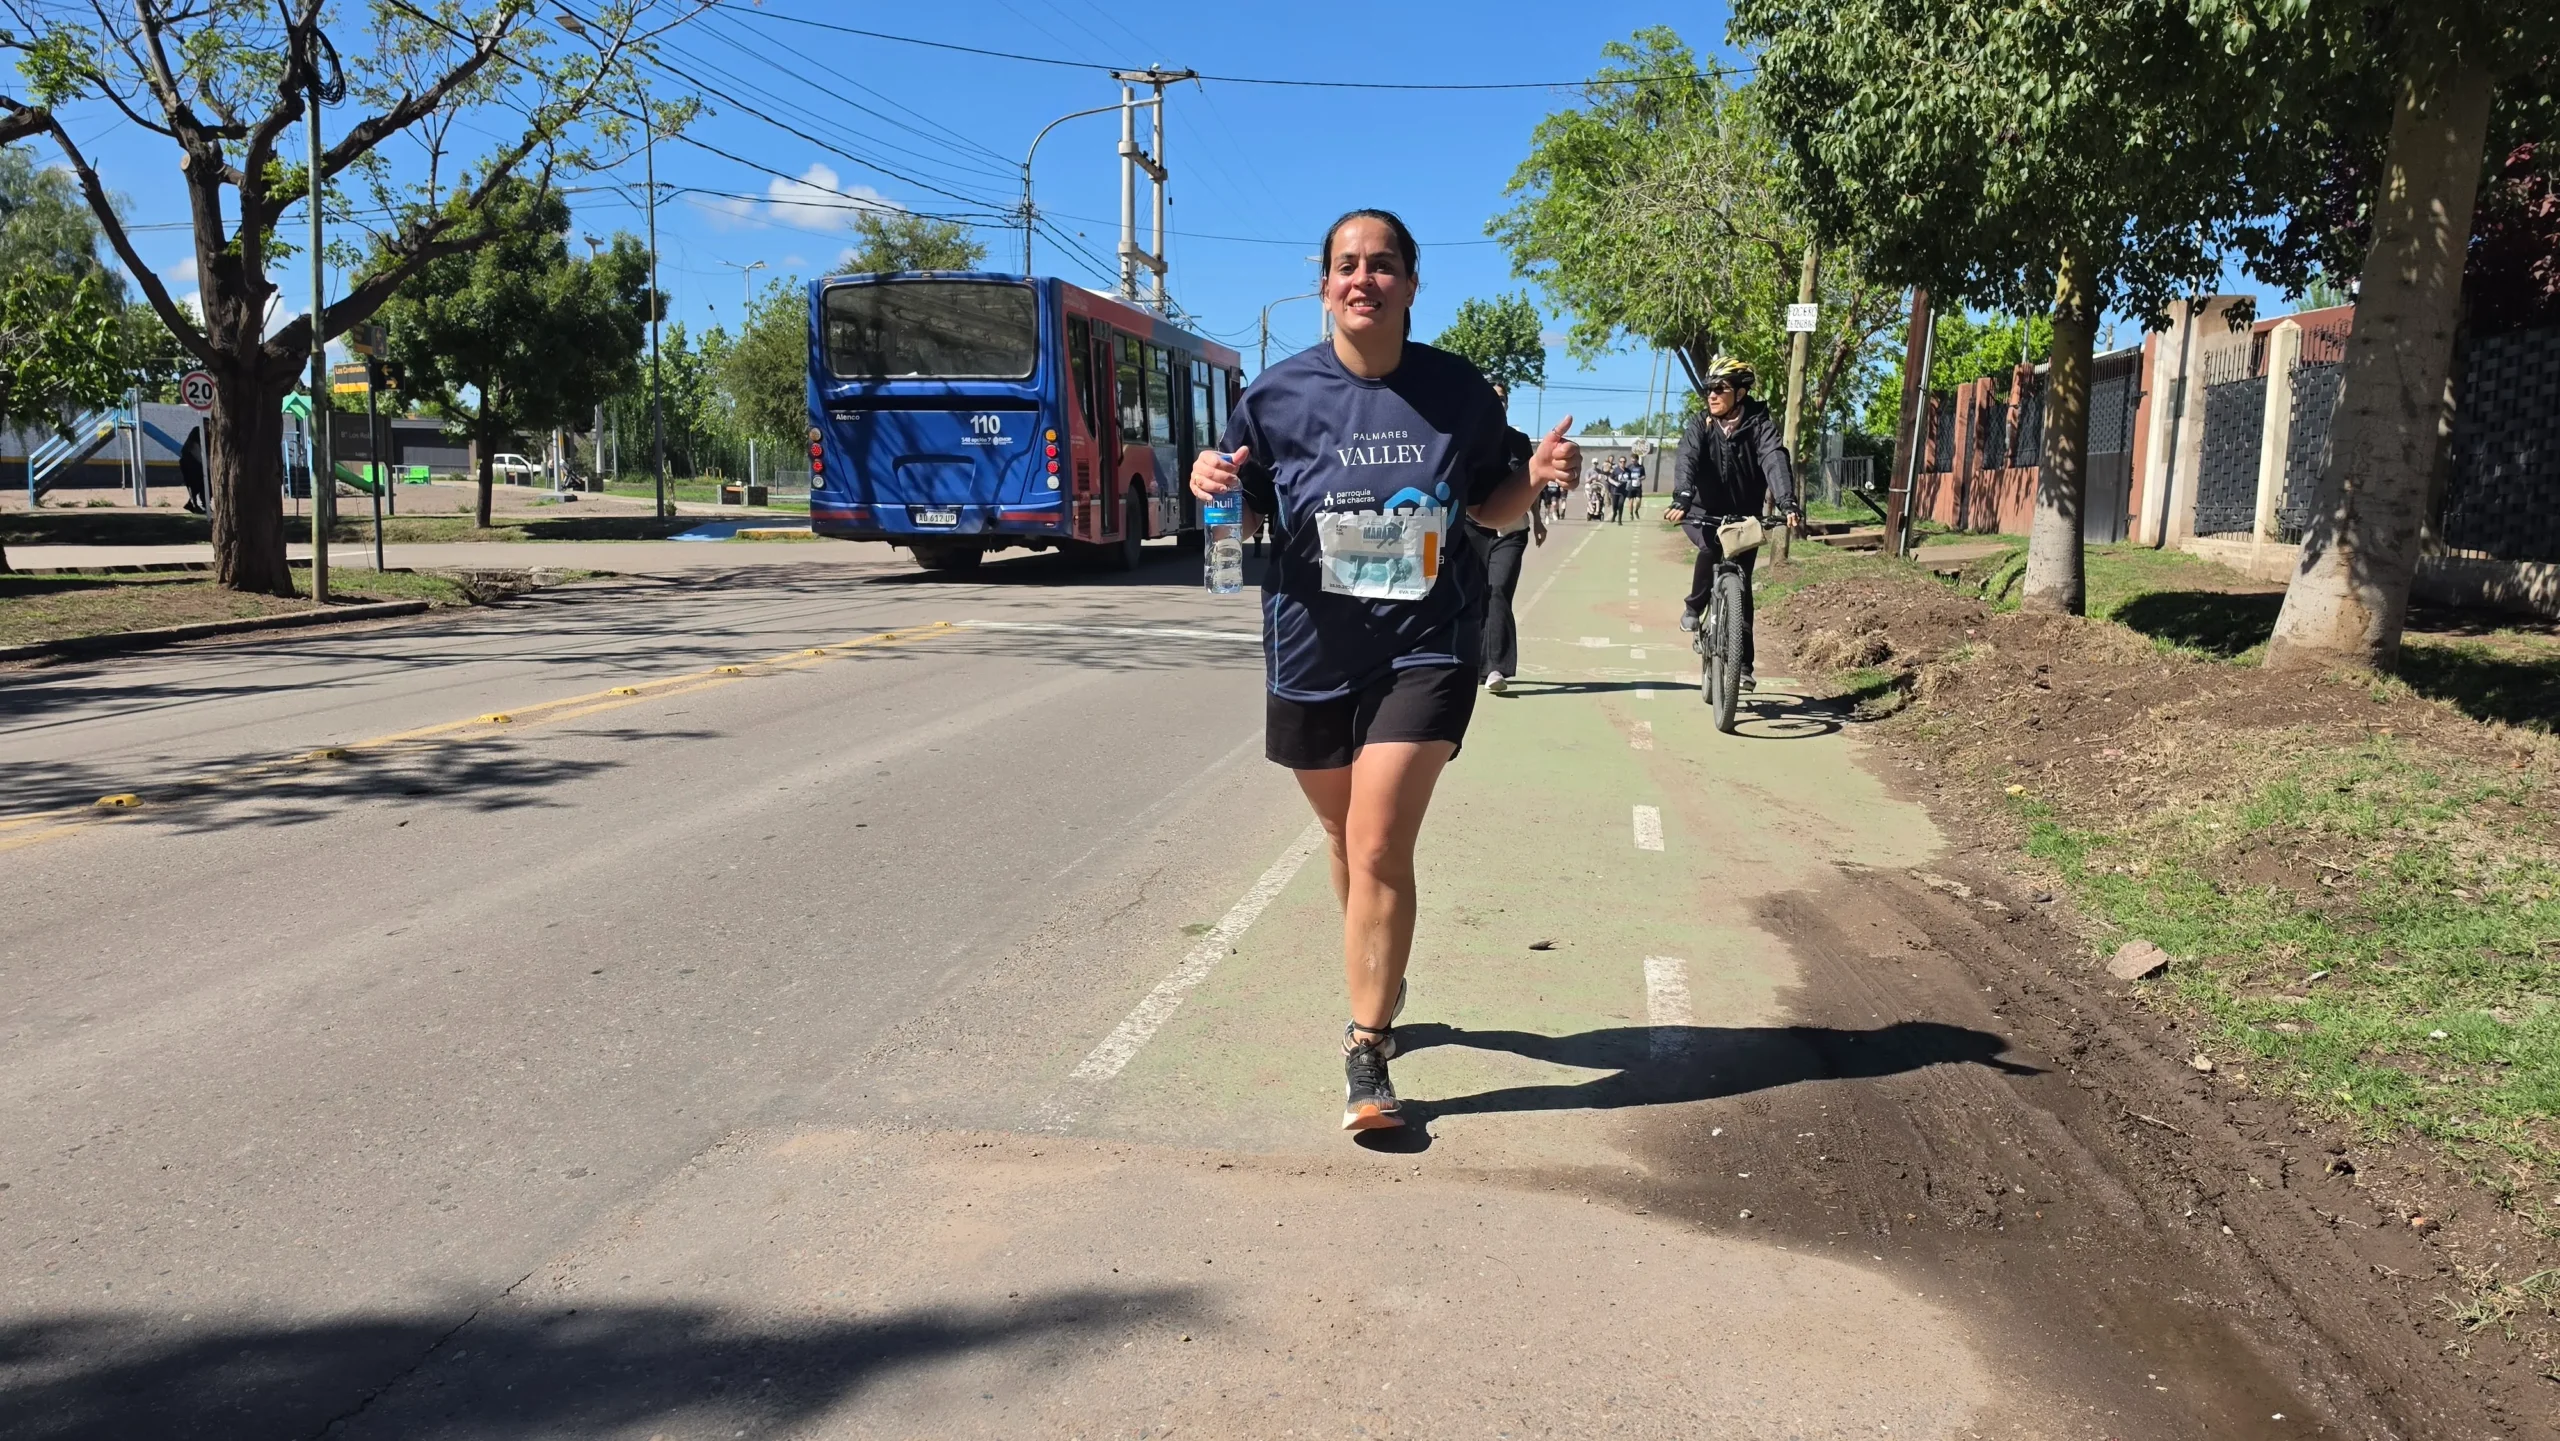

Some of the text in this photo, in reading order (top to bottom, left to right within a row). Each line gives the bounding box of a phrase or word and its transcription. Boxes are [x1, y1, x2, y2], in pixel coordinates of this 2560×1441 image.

[188, 381, 213, 400] 20
[835, 413, 860, 421] Alenco
[970, 414, 1001, 435] 110
[1353, 430, 1409, 441] PALMARES
[1337, 444, 1426, 467] VALLEY
[1336, 488, 1371, 499] parroquia
[1346, 496, 1376, 504] chacras
[918, 514, 955, 523] AD 612 UP
